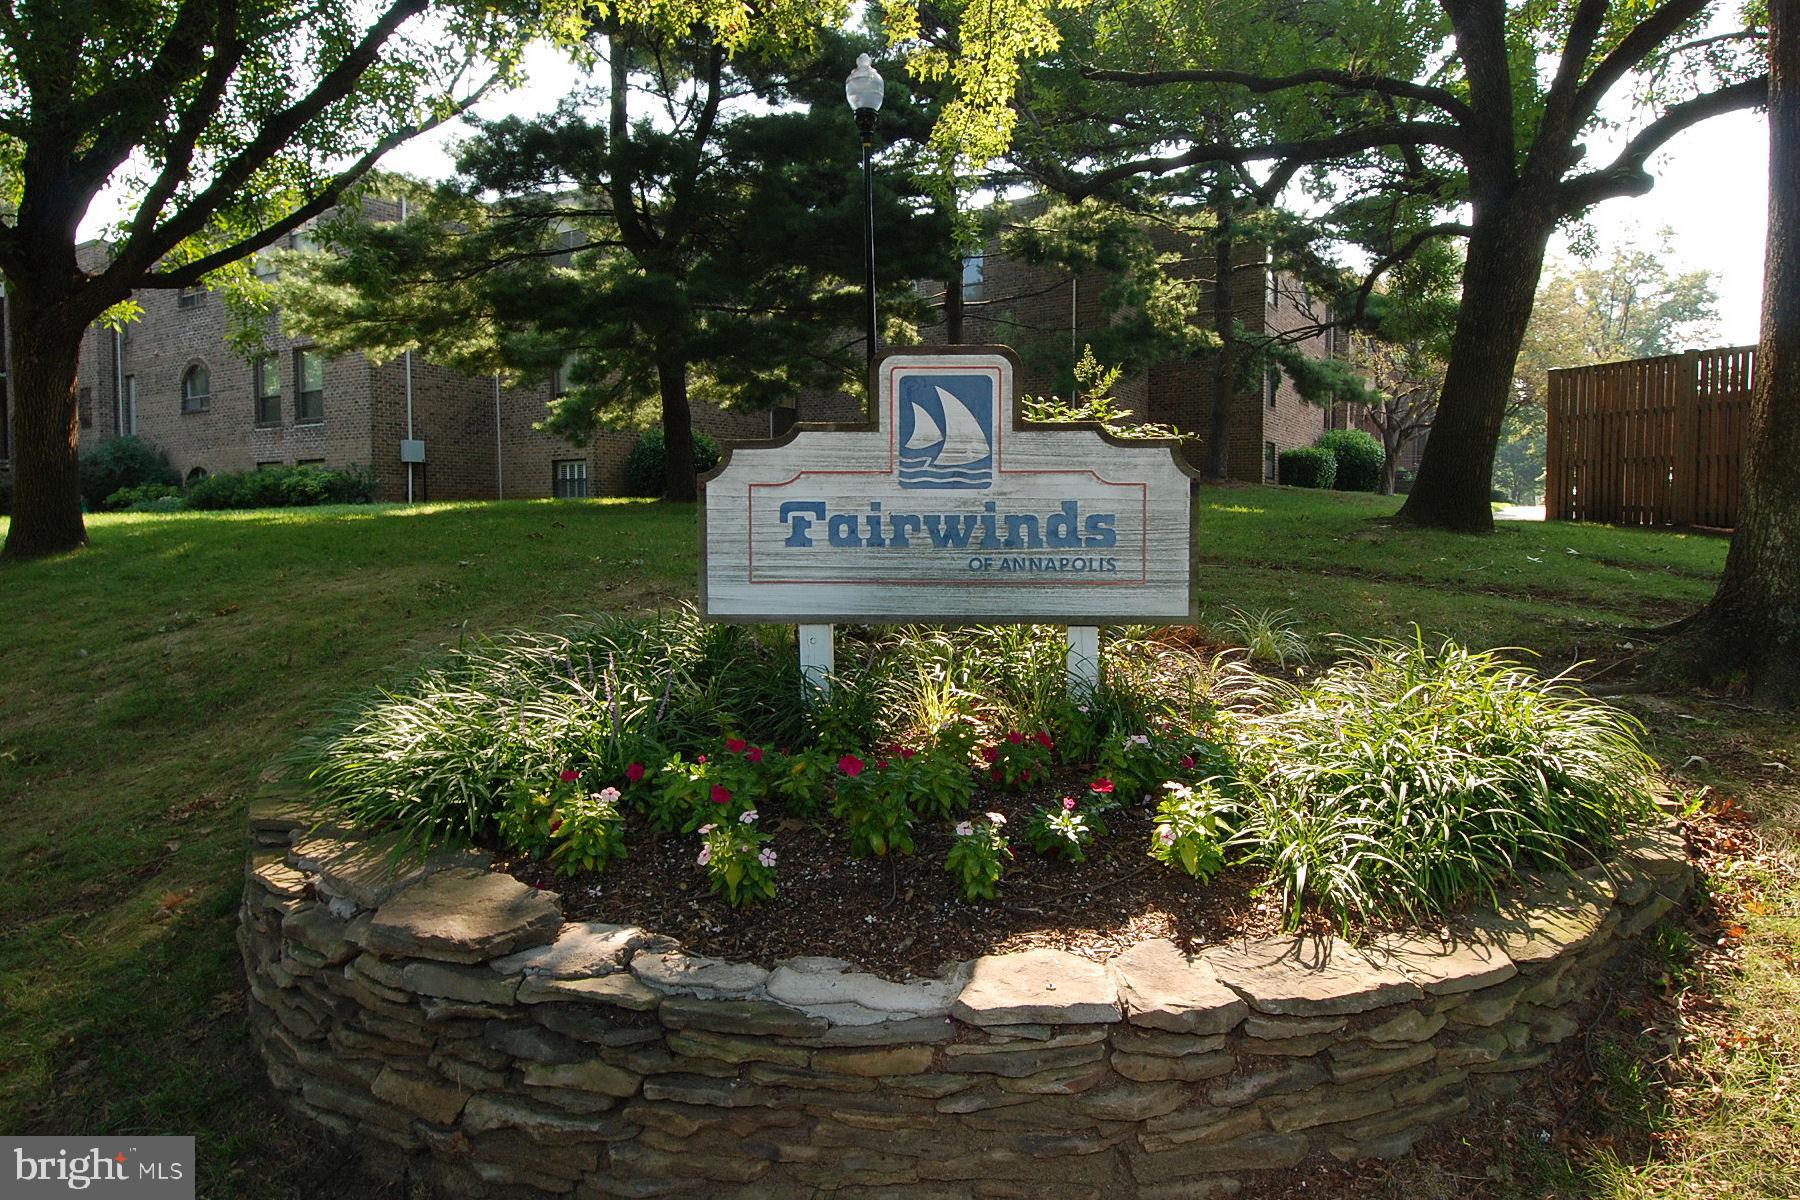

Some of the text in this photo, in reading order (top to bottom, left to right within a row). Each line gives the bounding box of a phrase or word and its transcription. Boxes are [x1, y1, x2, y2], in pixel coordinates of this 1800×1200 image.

[779, 500, 1117, 548] Fairwinds
[968, 556, 1117, 573] OF ANNAPOLIS
